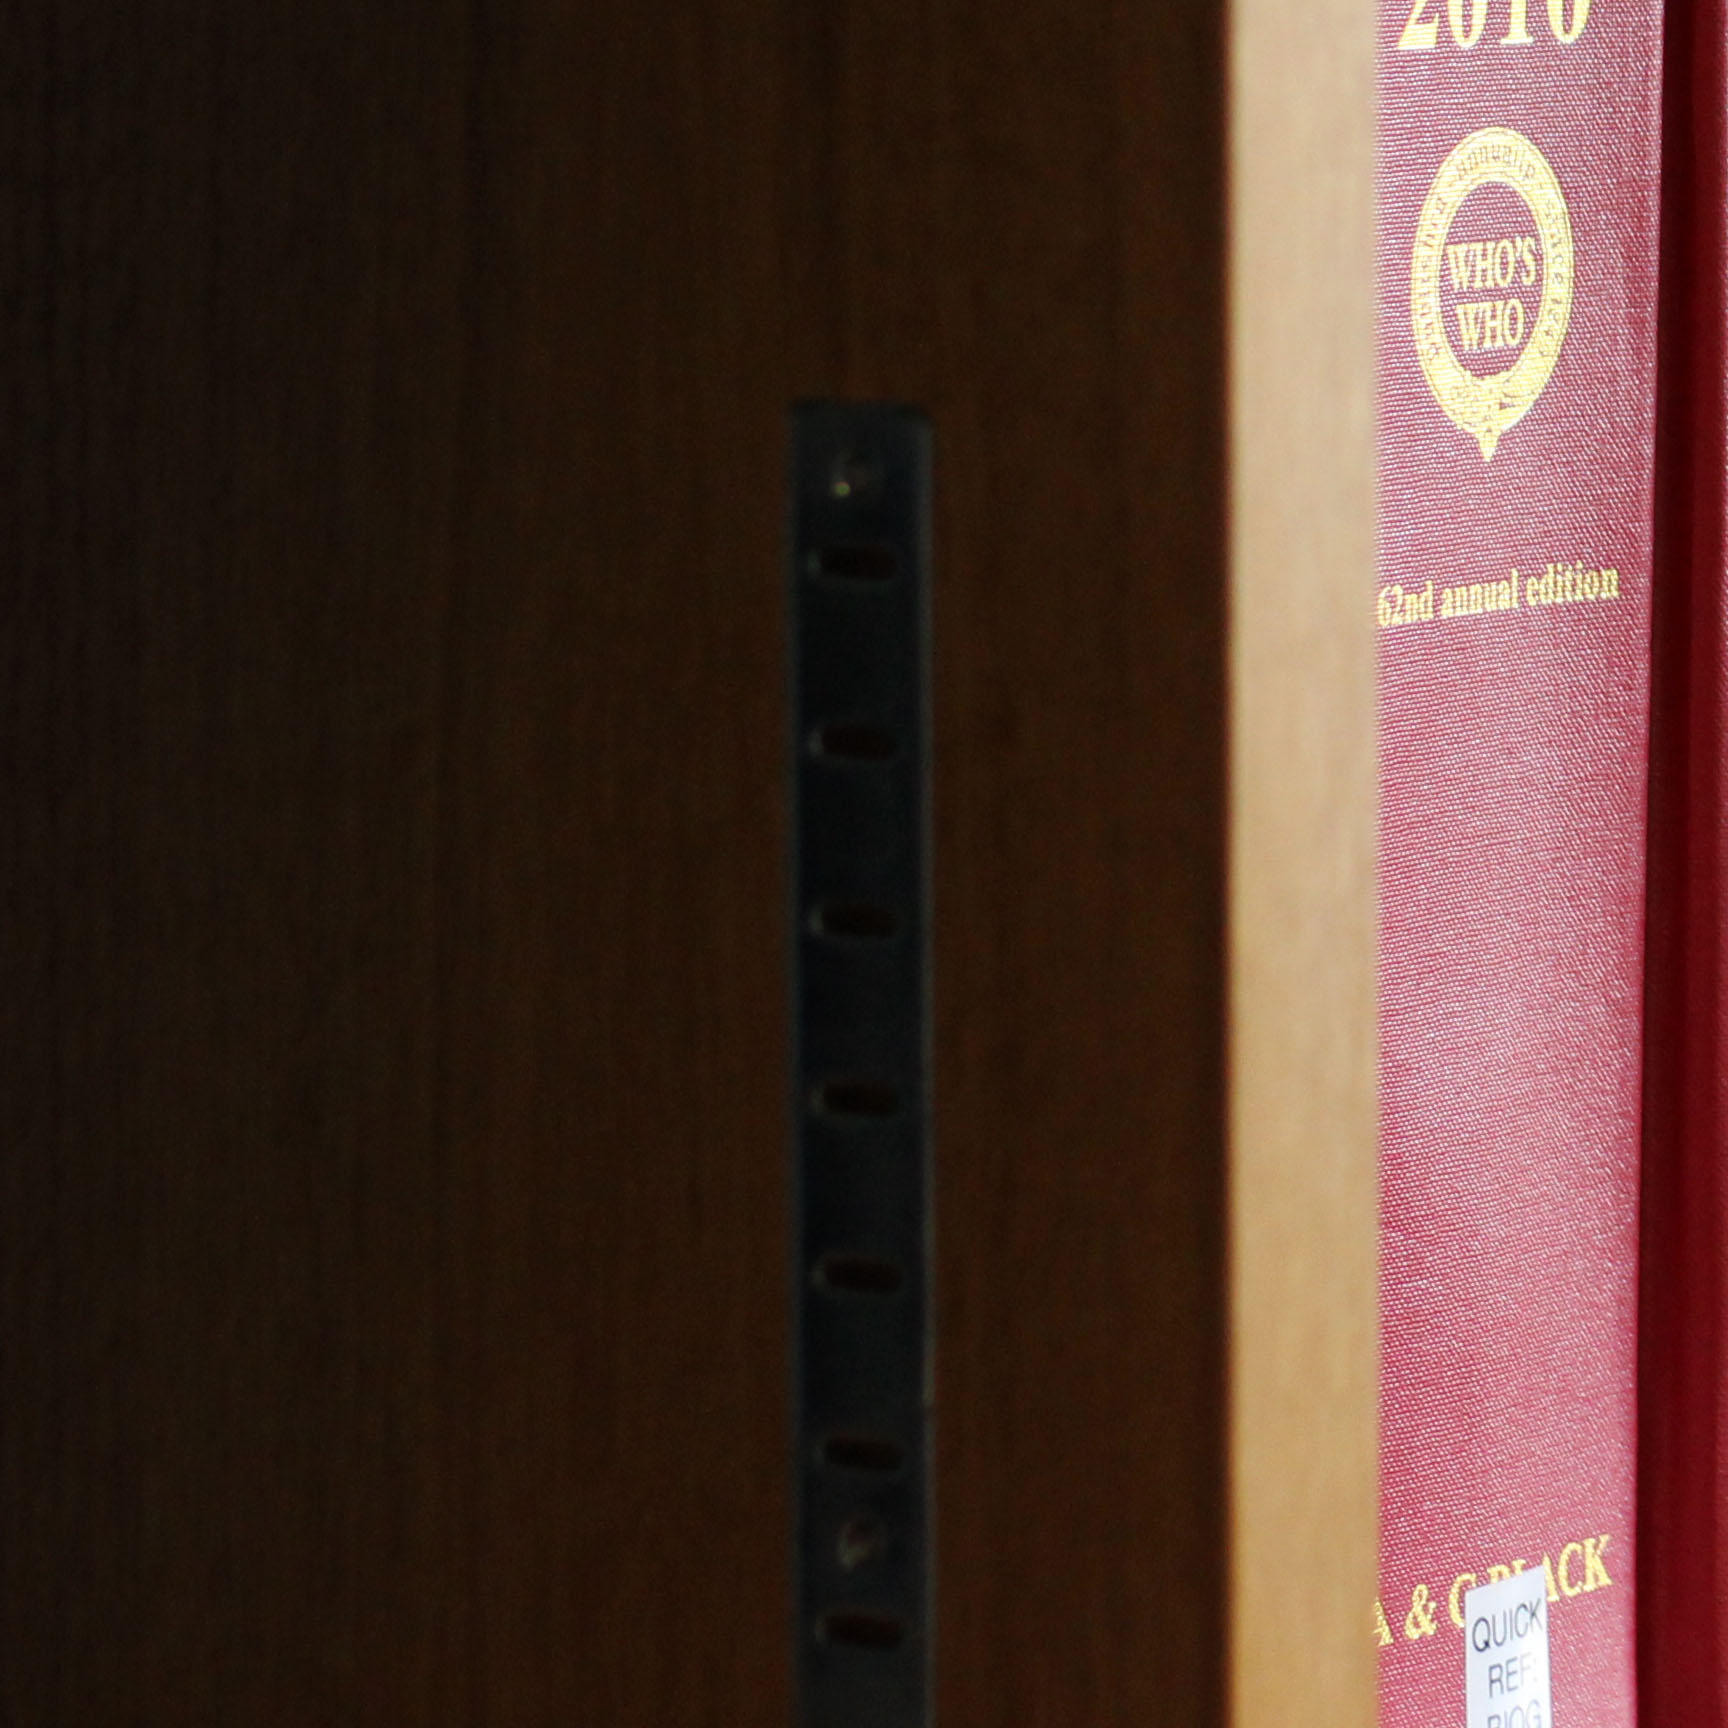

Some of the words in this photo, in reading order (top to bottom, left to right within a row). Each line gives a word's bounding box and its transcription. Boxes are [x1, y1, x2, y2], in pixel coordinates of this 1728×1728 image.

[1445, 236, 1537, 290] WHO'S
[1455, 299, 1524, 350] WHO
[1439, 568, 1520, 617] annual
[1526, 560, 1620, 606] edition
[1405, 1584, 1437, 1639] &
[1472, 1597, 1543, 1653] QUICK
